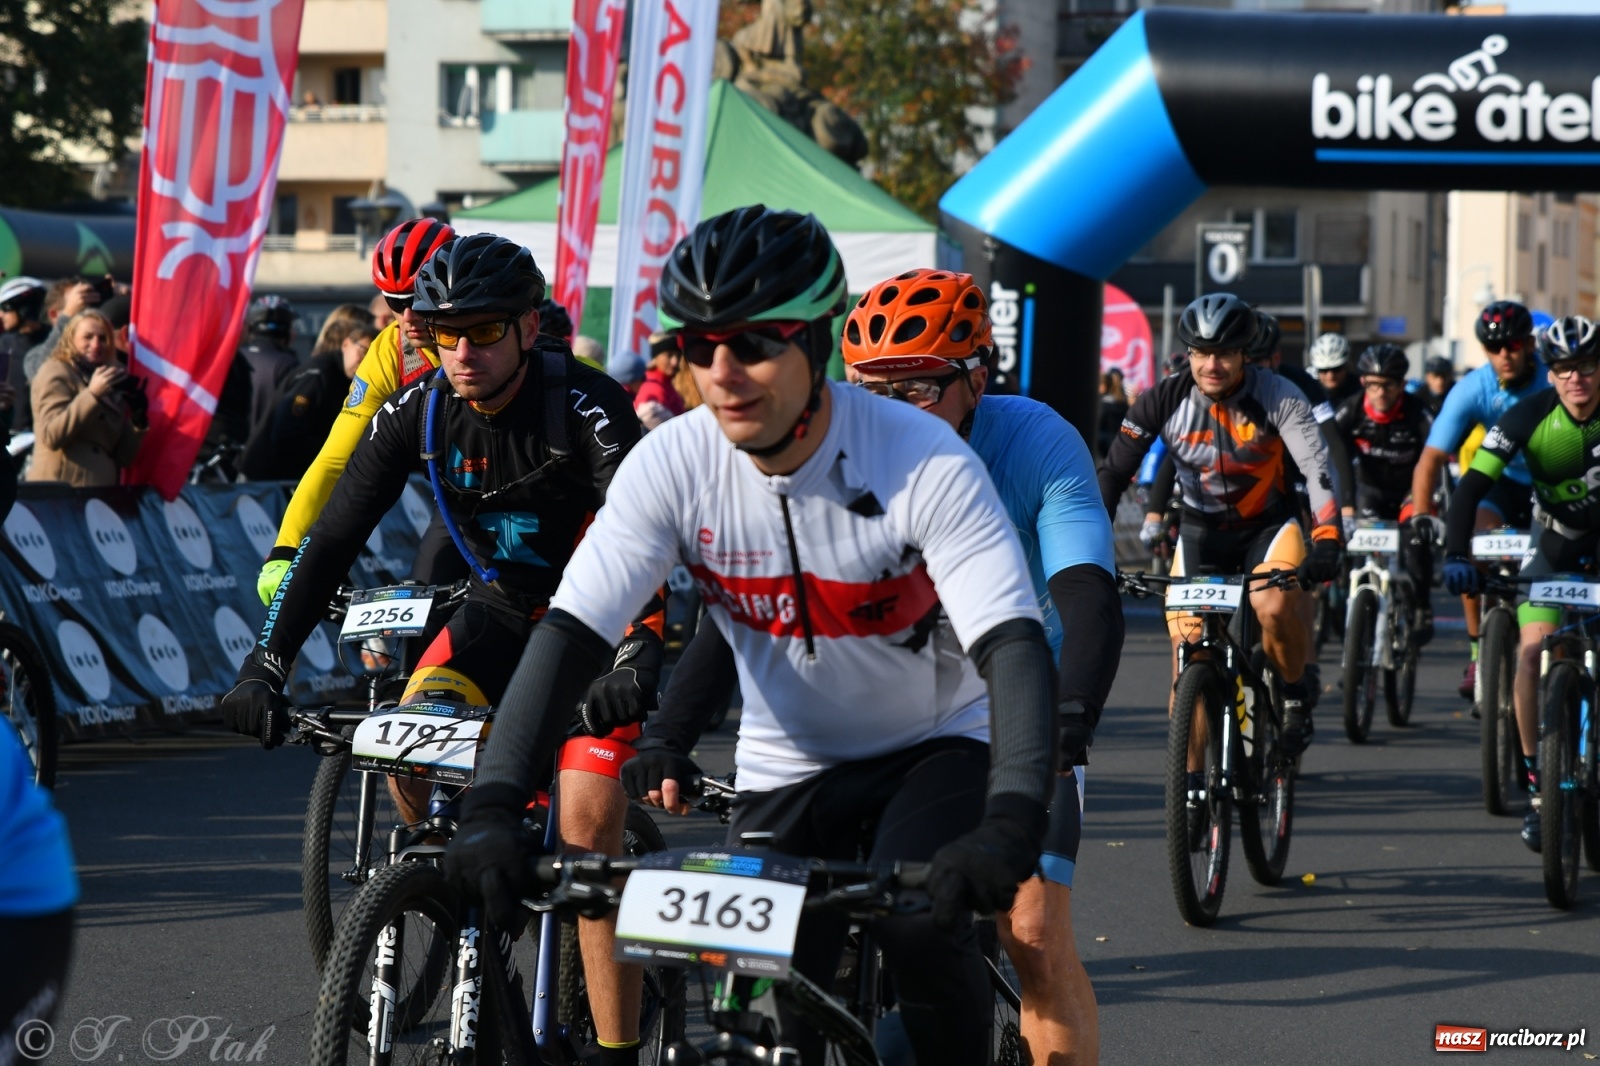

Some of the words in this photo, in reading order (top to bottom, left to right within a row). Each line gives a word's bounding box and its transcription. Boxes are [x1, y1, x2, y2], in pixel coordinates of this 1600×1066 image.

[1311, 72, 1457, 142] bike
[1208, 242, 1238, 284] 0
[1357, 536, 1390, 547] 1427
[1485, 538, 1523, 550] 3154
[104, 579, 162, 598] KOKOwear
[1181, 588, 1228, 601] 1291
[1541, 586, 1589, 599] 2144
[356, 606, 415, 627] 2256
[375, 720, 459, 752] 1797
[589, 747, 616, 758] FORZA
[658, 887, 774, 933] 3163
[459, 991, 482, 1050] FOX
